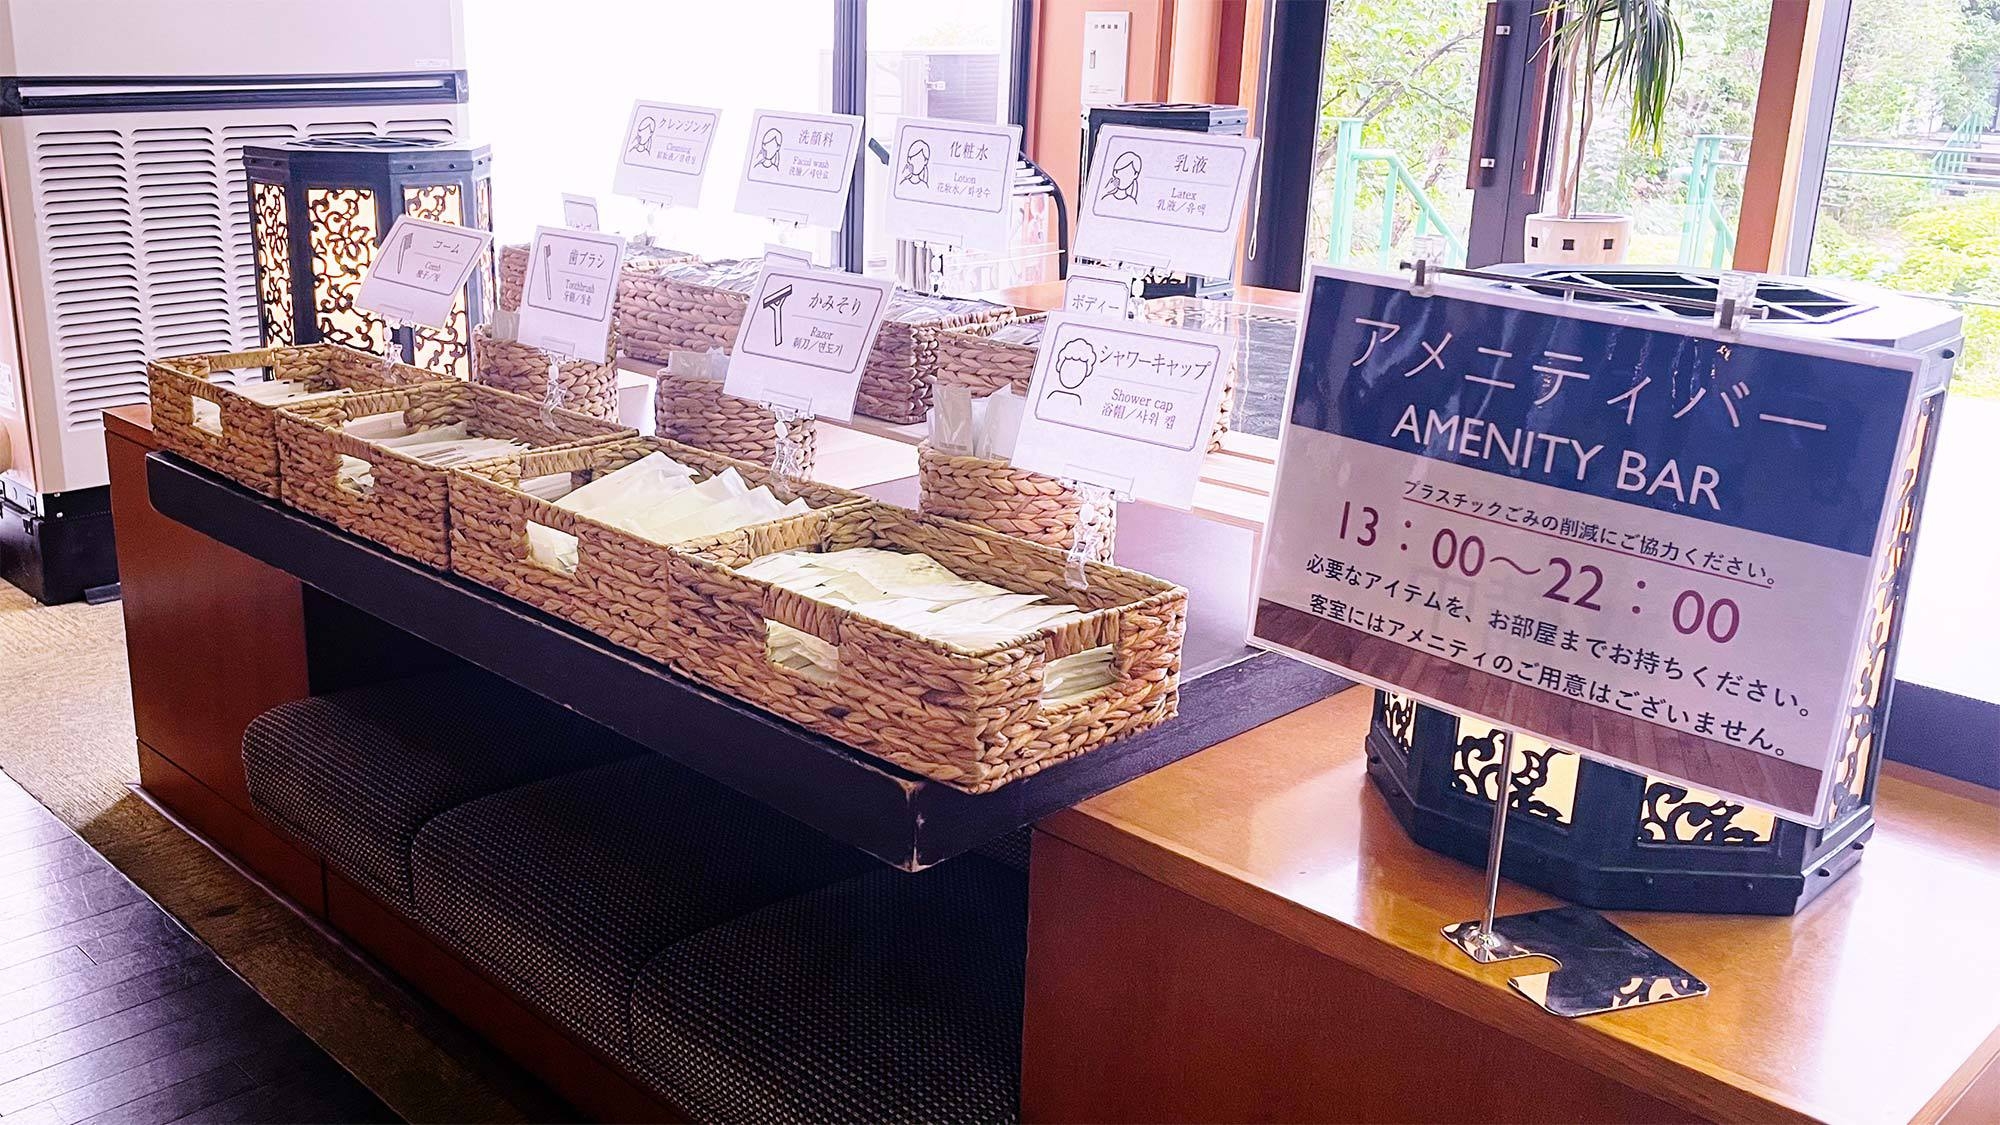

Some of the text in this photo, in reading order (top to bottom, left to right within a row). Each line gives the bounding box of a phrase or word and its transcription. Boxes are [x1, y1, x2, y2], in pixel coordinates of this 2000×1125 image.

[659, 117, 711, 134] クレンジング
[798, 129, 834, 148] 洗顔料
[950, 140, 989, 161] 化粧水
[1173, 153, 1209, 175] 乳液
[1171, 187, 1198, 201] Latex
[432, 240, 460, 254] コーム
[568, 249, 606, 270] 歯ブラシ
[808, 292, 862, 317] かみそり
[809, 326, 835, 342] Razor
[1099, 345, 1213, 381] シャワーキャップ
[1352, 317, 1828, 431] アメニティバー
[1111, 388, 1174, 413] Shower cap
[1391, 404, 1722, 511] AMENITY BAR
[1403, 480, 1776, 586] プラスチックごみの削減にご協力ください。
[1306, 553, 1809, 718] 必要なアイテムを、お部屋までお持ちください。
[1309, 592, 1785, 758] 客室にはアメニティのご用意はございません。
